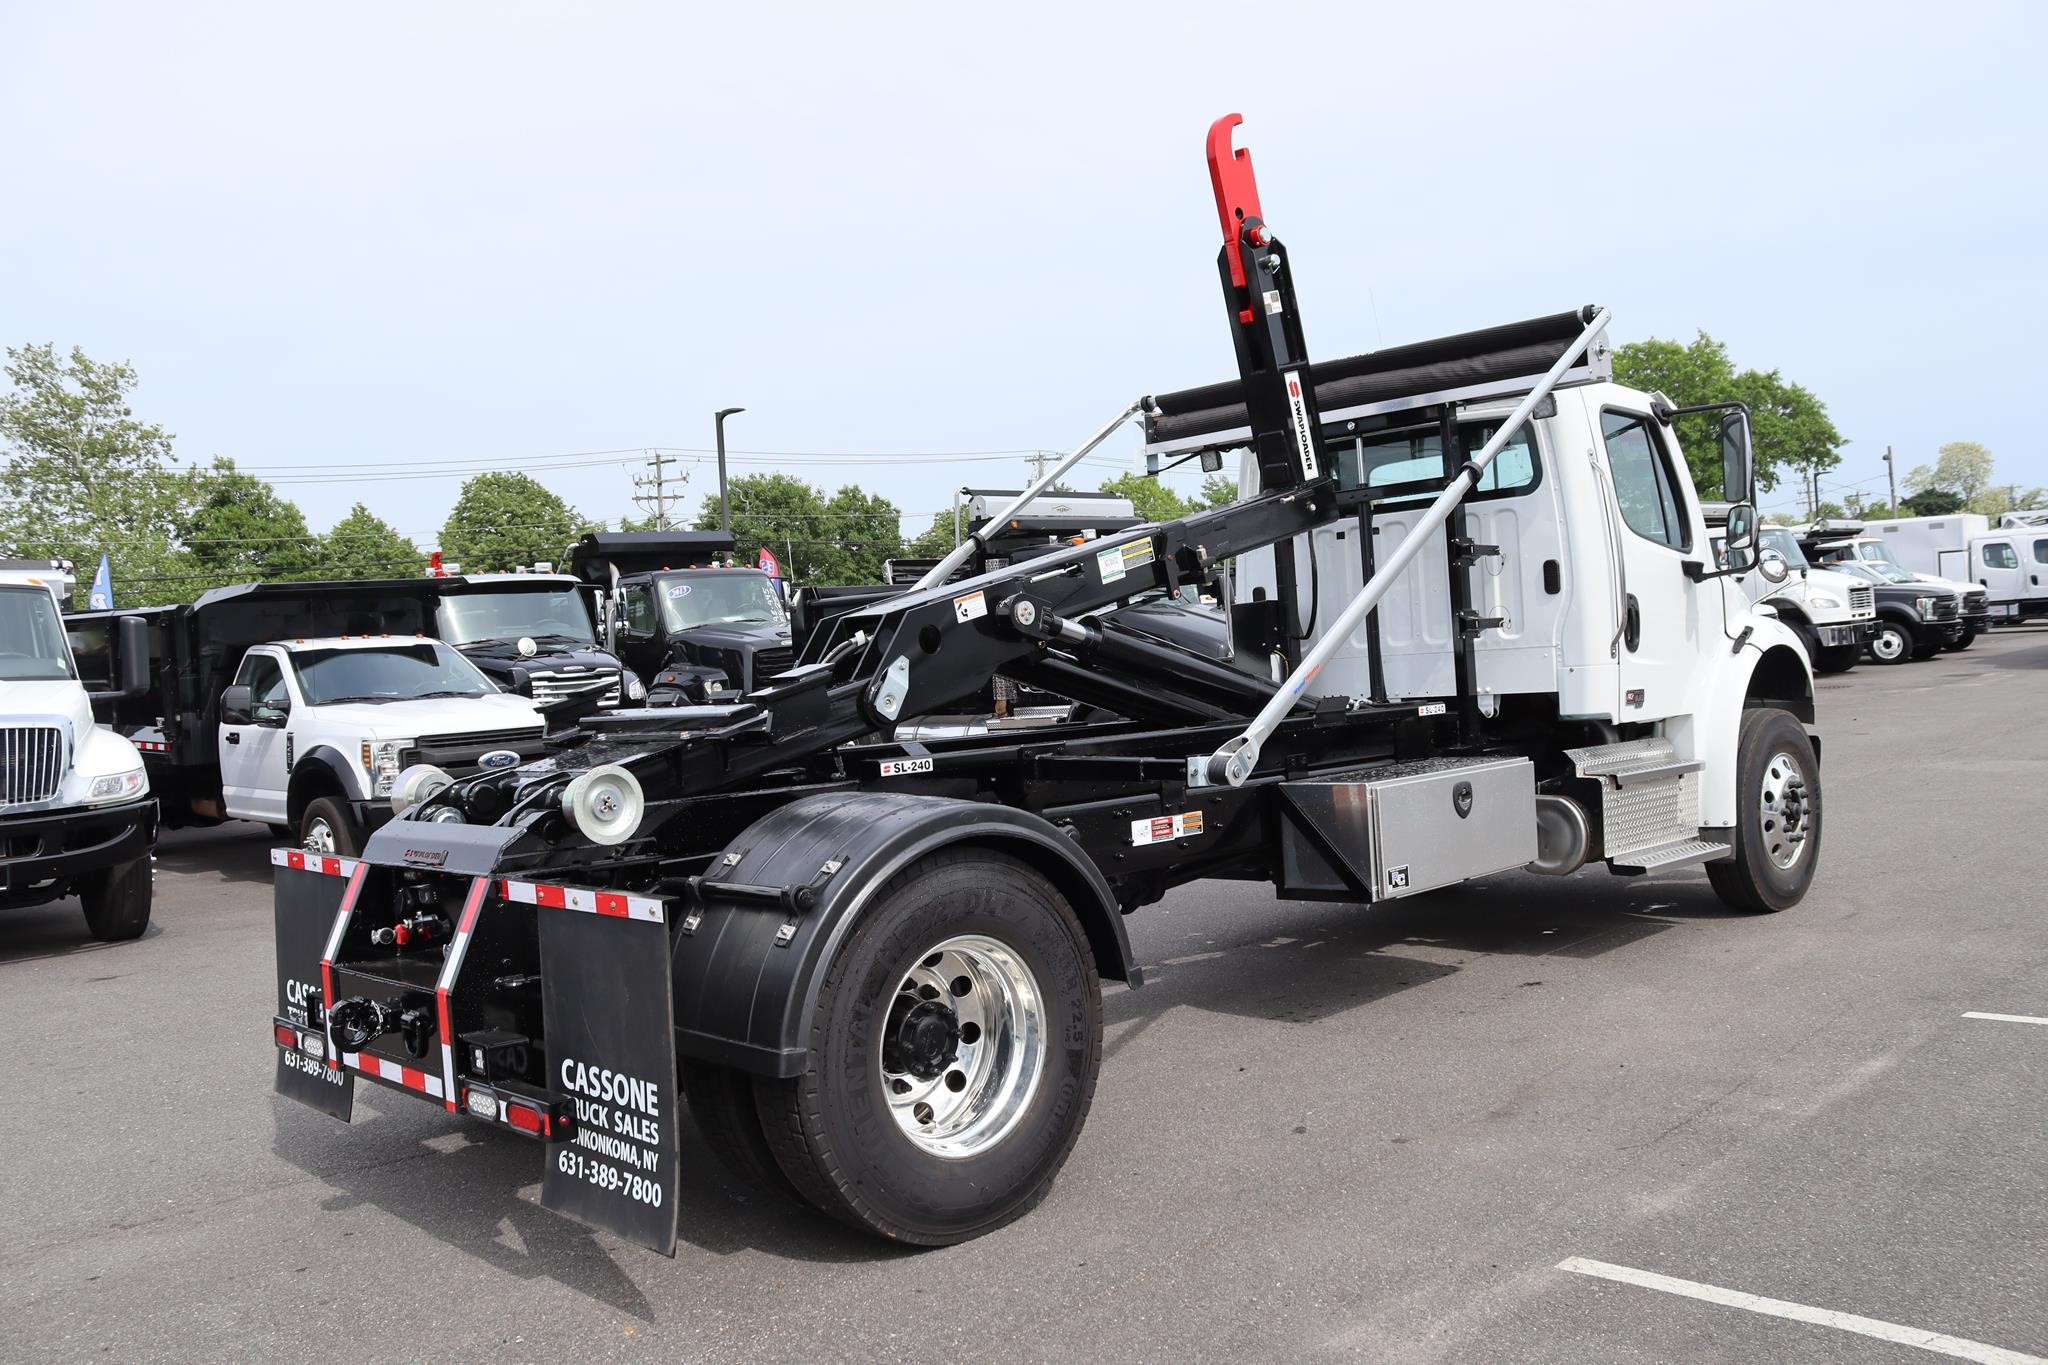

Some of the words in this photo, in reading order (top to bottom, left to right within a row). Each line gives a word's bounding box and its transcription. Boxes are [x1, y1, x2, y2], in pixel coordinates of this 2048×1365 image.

[1294, 400, 1312, 470] SWAPLOADER
[893, 759, 931, 774] SL-240
[561, 1058, 659, 1117] CASSONE
[574, 1097, 609, 1130] RUCK
[614, 1110, 660, 1146] SALES
[571, 1126, 641, 1170] NKONKOMA,
[643, 1149, 659, 1173] NY
[558, 1150, 662, 1208] 631-389-7800
